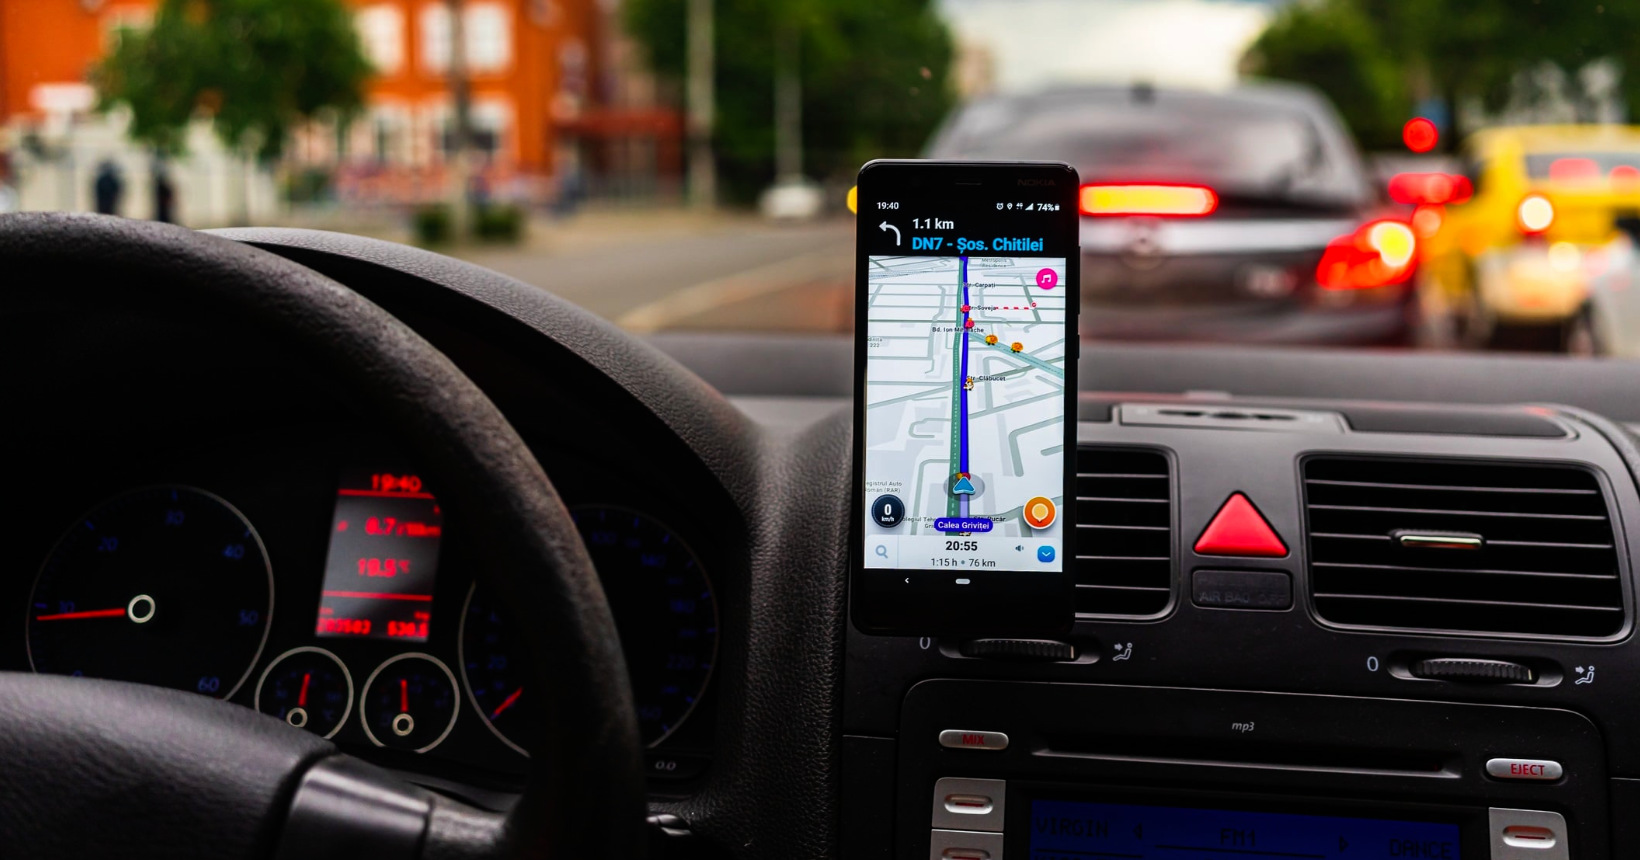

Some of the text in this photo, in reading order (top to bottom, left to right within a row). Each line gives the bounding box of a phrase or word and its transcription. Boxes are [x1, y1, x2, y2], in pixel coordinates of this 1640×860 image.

[1017, 178, 1057, 187] NOKIA
[876, 202, 900, 211] 19:40
[1036, 203, 1055, 212] 74%
[912, 218, 955, 230] 1.1 km
[912, 237, 943, 250] DN7
[957, 237, 989, 254] Șos.
[992, 237, 1044, 251] Chitilei
[884, 503, 892, 516] 0
[937, 521, 990, 531] Calea Griviței
[945, 540, 978, 551] 20:55
[931, 558, 996, 567] 1:15 h 76 km
[1231, 720, 1255, 733] mp3
[962, 733, 985, 746] MIX
[1510, 763, 1545, 777] EJECT
[1035, 816, 1109, 840] VIRGIN
[1220, 827, 1257, 847] FM1
[1389, 838, 1452, 860] DANCE
